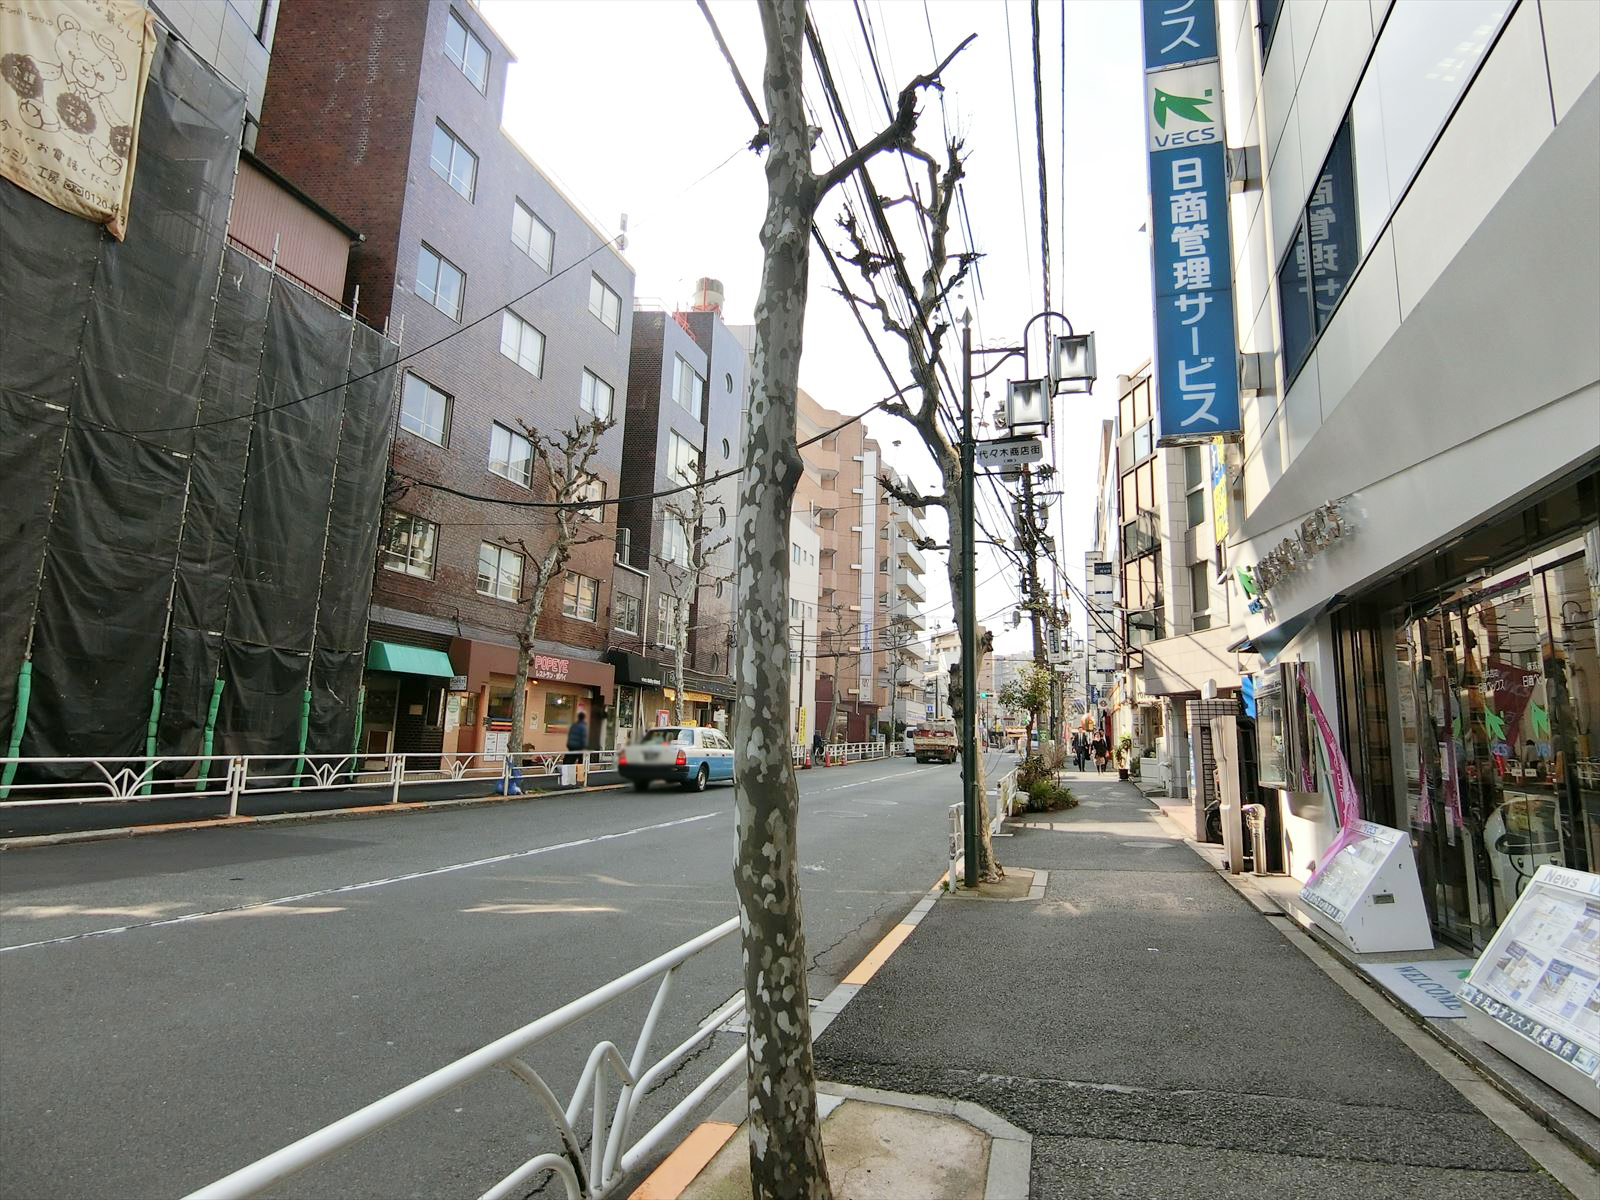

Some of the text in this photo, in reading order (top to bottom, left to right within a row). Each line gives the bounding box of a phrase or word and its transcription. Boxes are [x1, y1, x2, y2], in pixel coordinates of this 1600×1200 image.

[1155, 127, 1216, 148] VECS
[0, 143, 60, 185] ァミリー工房
[1169, 157, 1219, 427] 日商管理サービス
[978, 445, 1041, 459] 代々木商店街
[534, 655, 569, 674] POPEYE
[1544, 868, 1580, 889] News
[1393, 966, 1462, 1011] WELCOME
